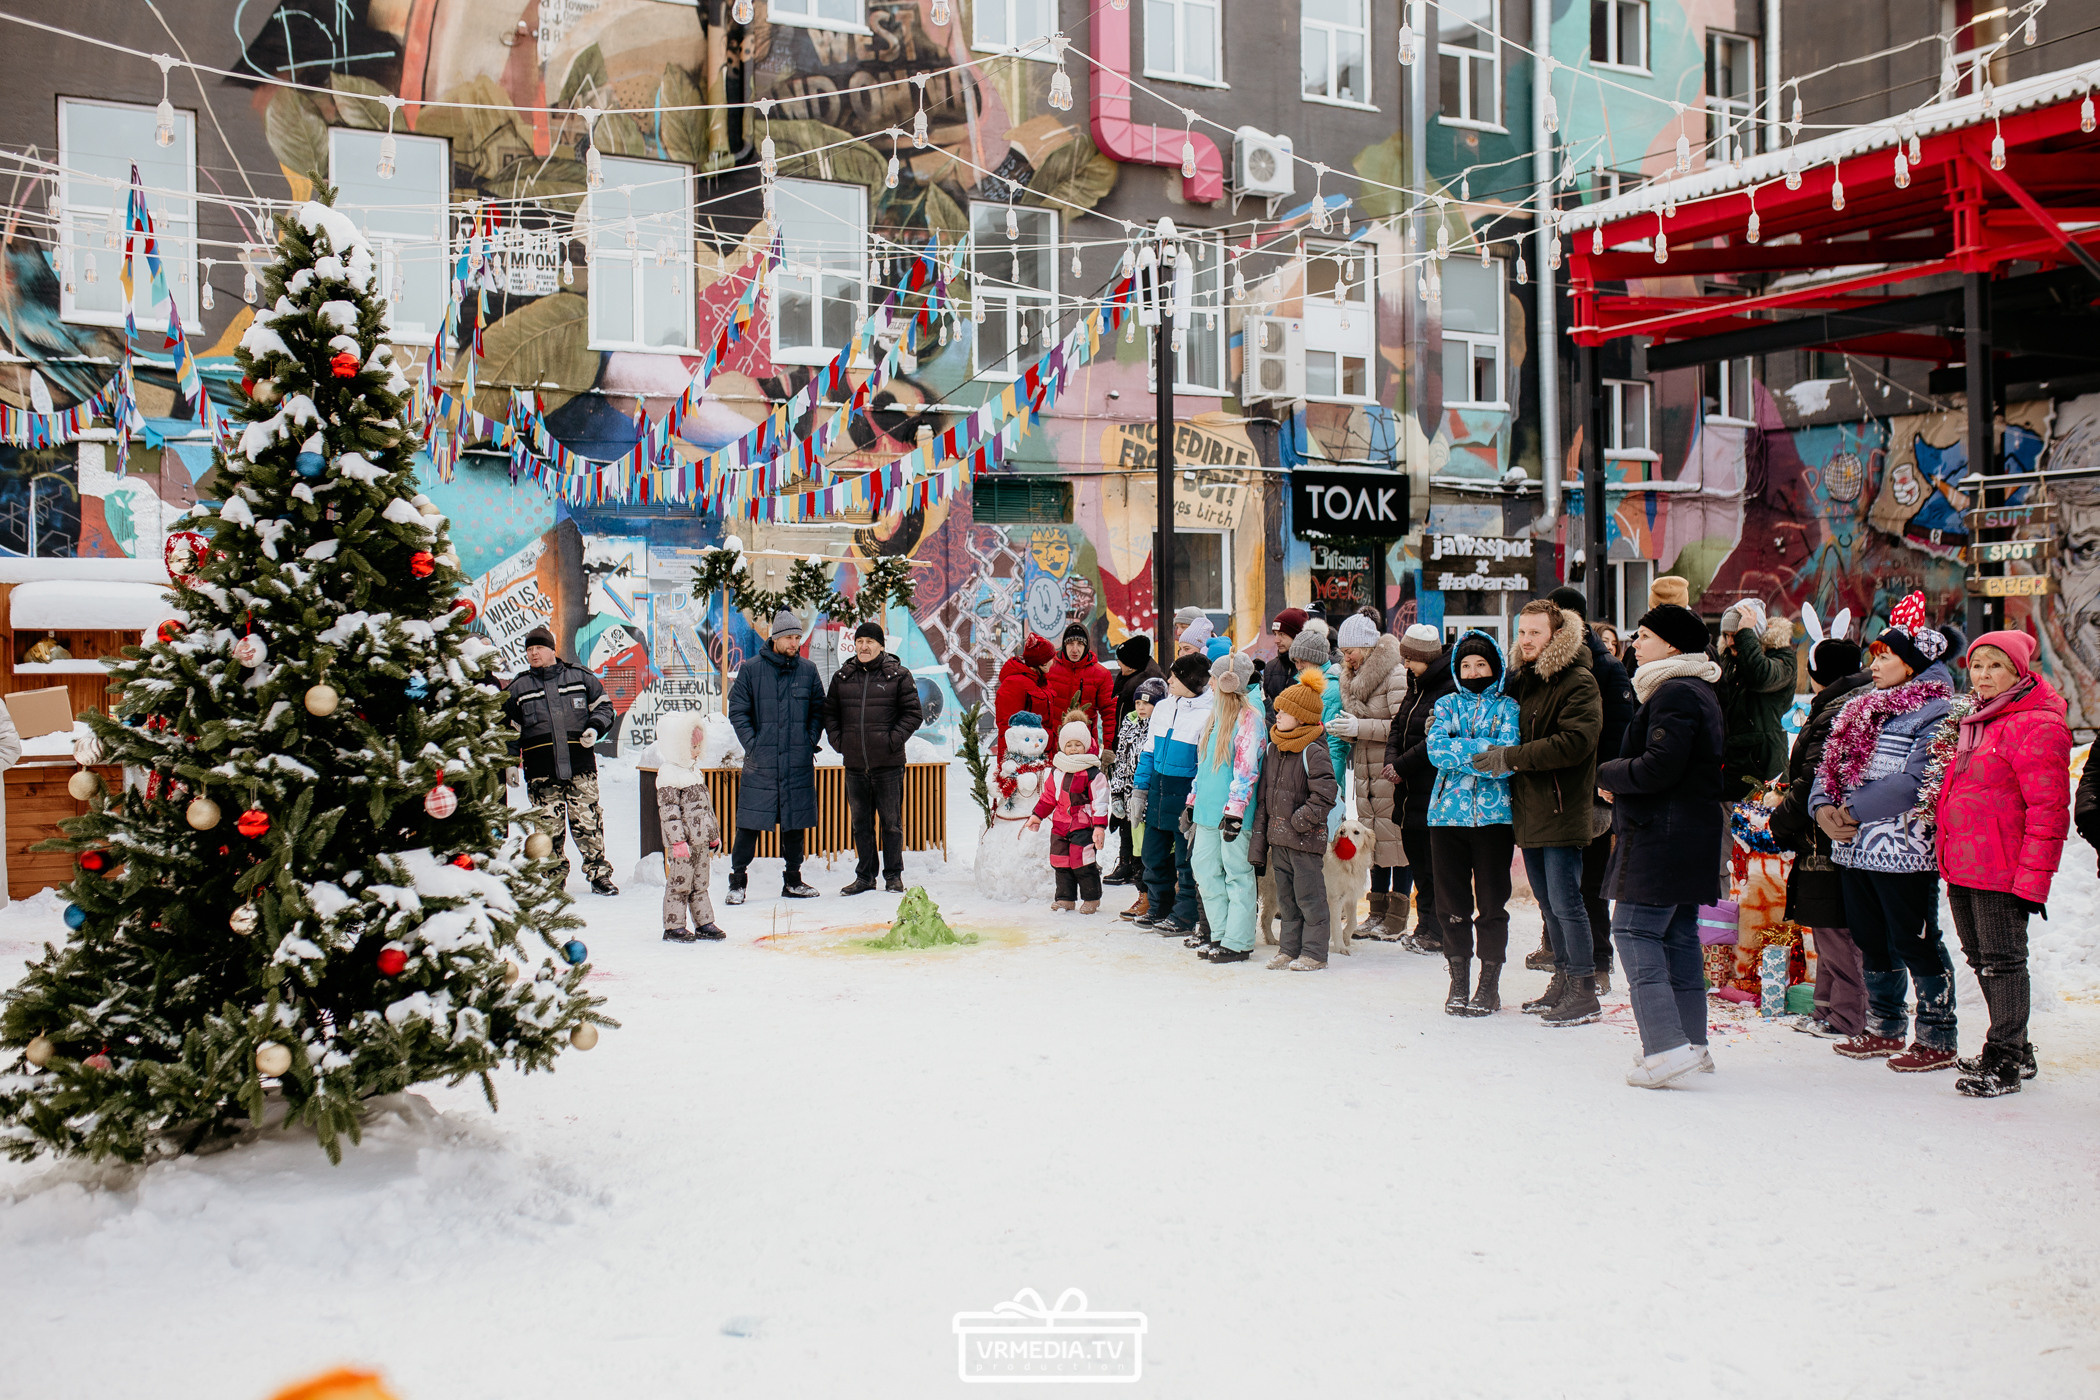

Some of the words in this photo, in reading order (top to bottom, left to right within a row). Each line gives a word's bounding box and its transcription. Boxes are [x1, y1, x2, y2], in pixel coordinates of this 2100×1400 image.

[807, 10, 917, 66] WEST
[511, 252, 556, 271] MOON
[1197, 502, 1233, 527] birth
[1989, 543, 2036, 560] SPOT
[1990, 580, 2044, 594] BEER
[485, 596, 520, 625] WHO
[518, 586, 536, 605] IS
[641, 678, 674, 695] WHAT
[679, 679, 722, 696] WOULD
[654, 698, 680, 711] YOU
[684, 698, 703, 711] DO
